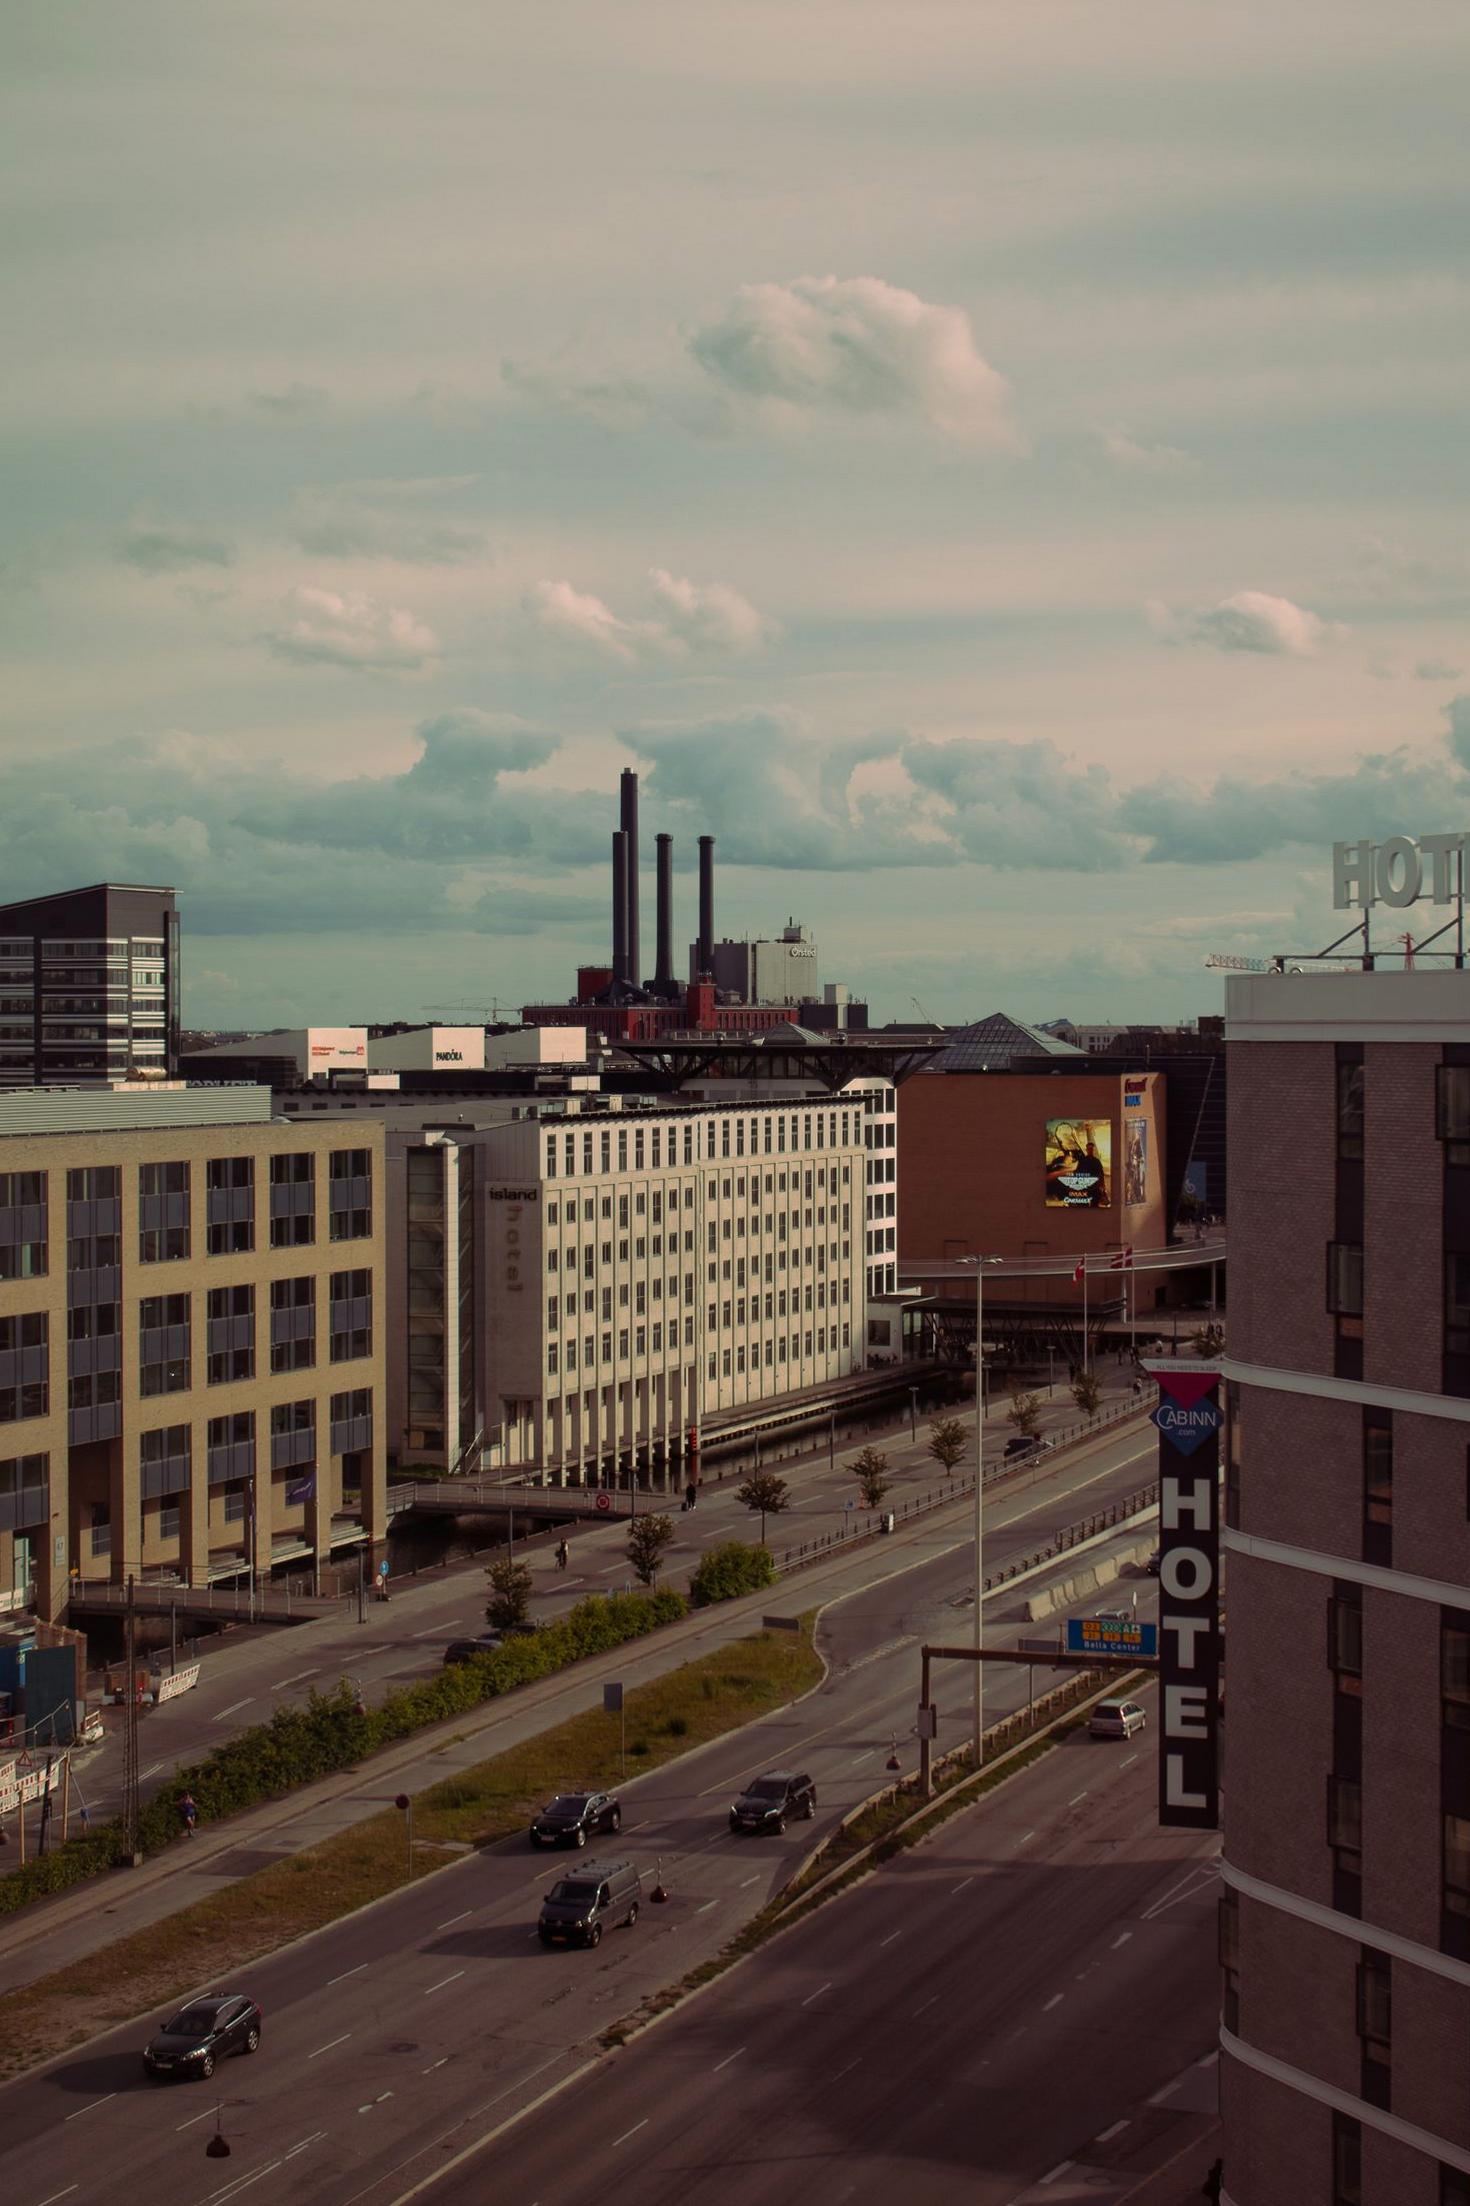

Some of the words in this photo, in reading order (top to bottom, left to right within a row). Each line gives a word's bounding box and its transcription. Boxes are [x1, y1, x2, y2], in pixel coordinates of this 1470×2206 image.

[1333, 831, 1470, 909] HOT
[489, 1188, 537, 1201] island
[1156, 1405, 1216, 1430] CABINN
[1083, 1640, 1107, 1649] Bella
[1110, 1642, 1141, 1652] Center
[1159, 1476, 1213, 1809] HOTEL
